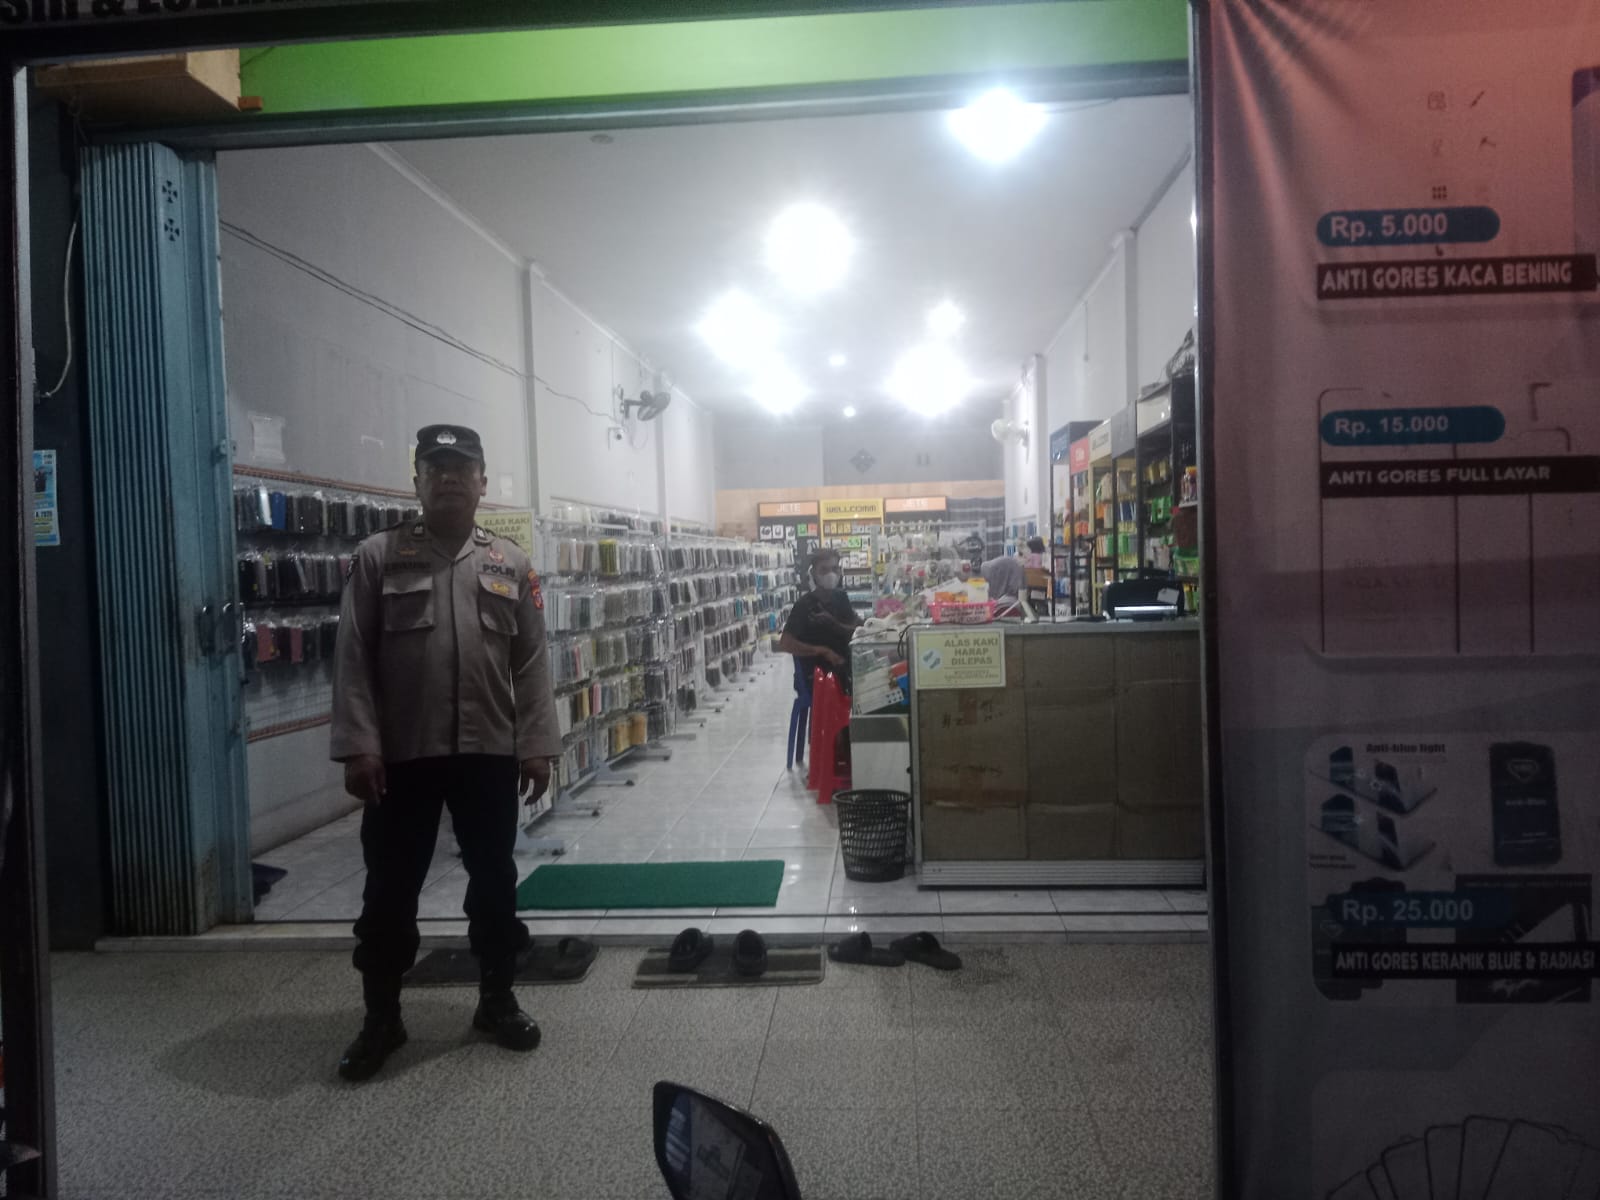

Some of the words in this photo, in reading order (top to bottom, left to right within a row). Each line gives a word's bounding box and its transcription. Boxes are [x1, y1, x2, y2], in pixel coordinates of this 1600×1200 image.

[1331, 216, 1373, 241] Rp.
[1381, 213, 1448, 236] 5.000
[1322, 269, 1367, 292] ANTI
[1373, 266, 1437, 289] GORES
[1444, 264, 1496, 287] KACA
[1503, 262, 1572, 285] BENING
[1335, 418, 1371, 438] Rp.
[1380, 415, 1448, 433] 15.000
[1329, 470, 1372, 485] ANTI
[1377, 469, 1440, 484] GORES
[1447, 468, 1489, 482] FULL
[1494, 466, 1551, 481] LAYAR
[777, 503, 801, 514] JETE
[483, 565, 515, 577] POLRI
[945, 639, 970, 647] ALAS
[973, 638, 998, 646] KAKI
[952, 656, 992, 665] DILEPAS
[955, 648, 989, 656] HARAP
[1342, 900, 1385, 924] Rp.
[1394, 899, 1473, 921] 25.000
[1336, 952, 1368, 970] ANTI
[1372, 952, 1419, 970] GORES
[1422, 952, 1486, 970] KERAMIK
[1488, 952, 1523, 970] BLUE
[1525, 952, 1537, 970] &
[1540, 952, 1595, 970] RADIASI
